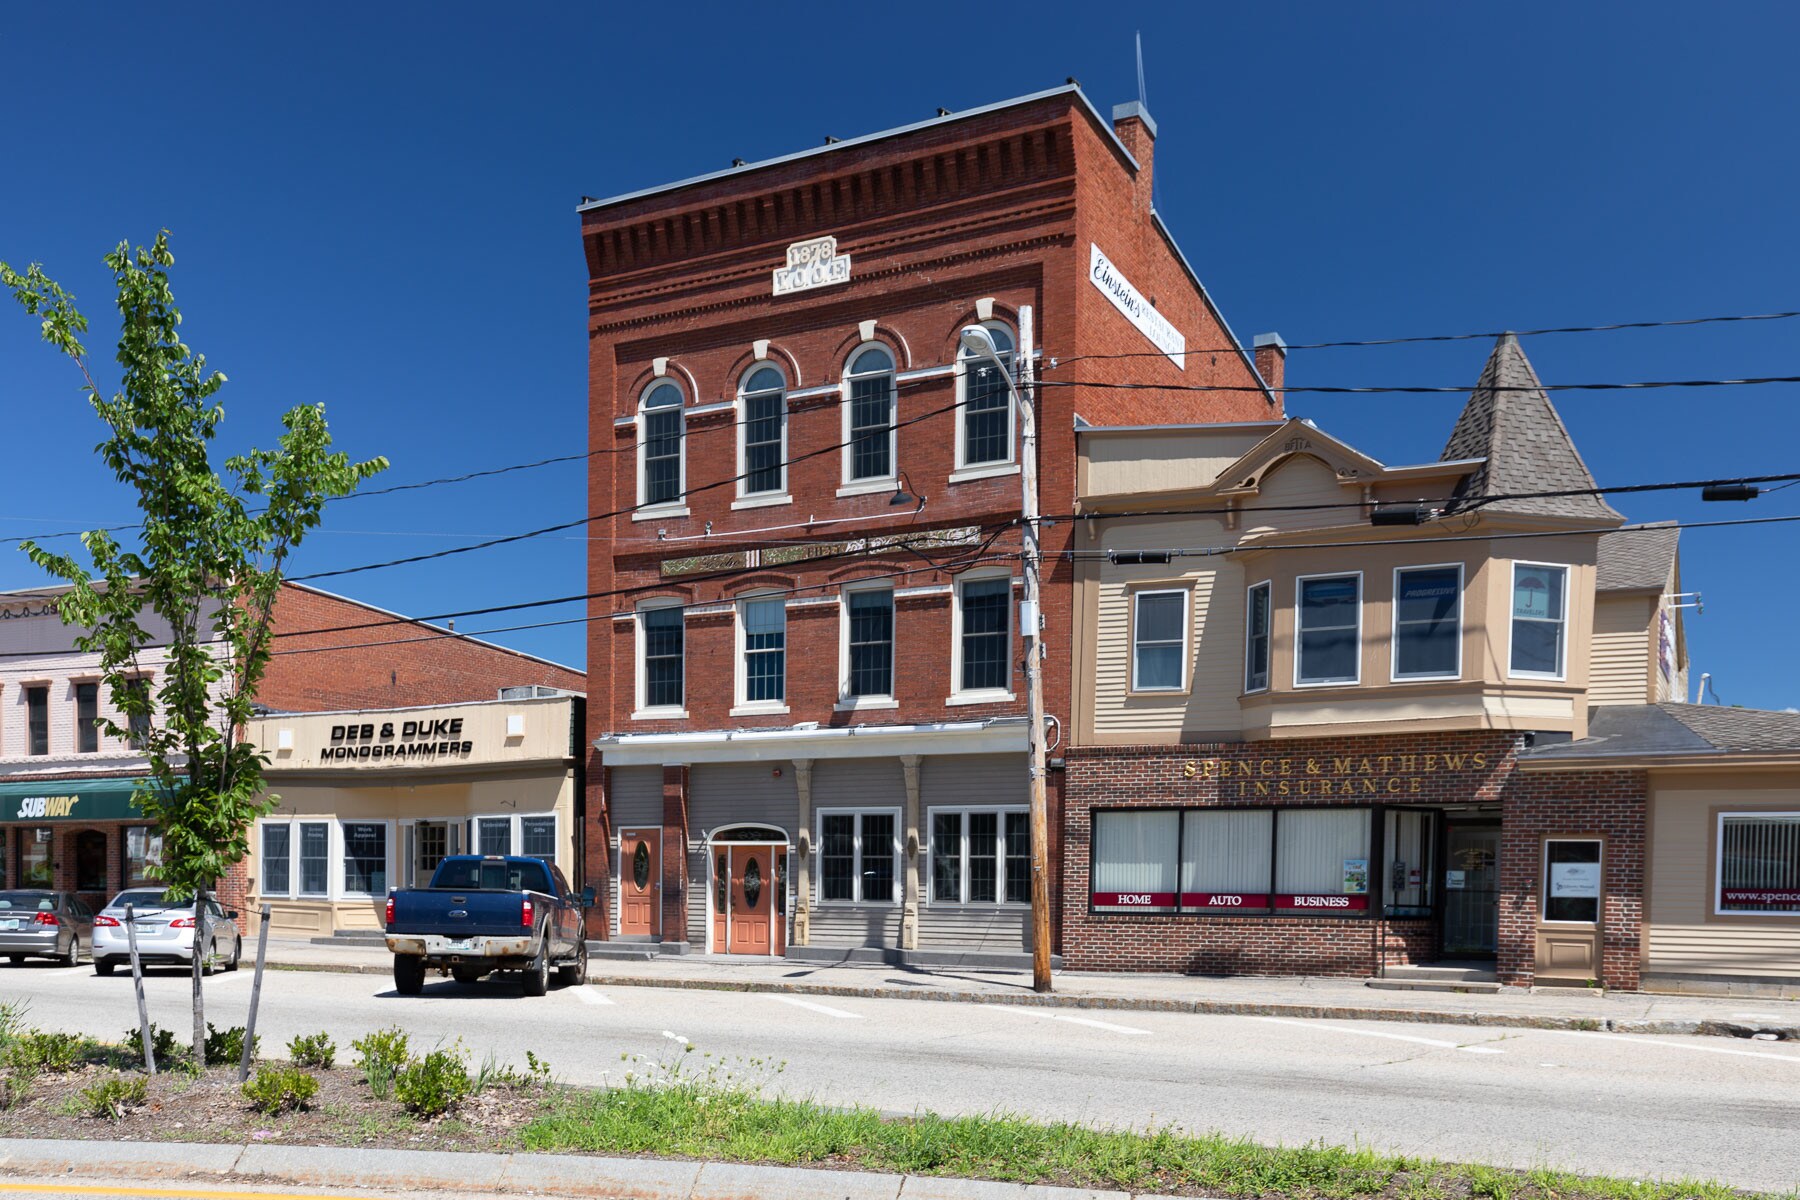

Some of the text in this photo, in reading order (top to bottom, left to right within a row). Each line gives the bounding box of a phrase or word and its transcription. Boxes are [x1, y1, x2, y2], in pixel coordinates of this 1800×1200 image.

[792, 242, 832, 265] 1878
[1093, 254, 1141, 318] Einstein's
[1404, 586, 1458, 598] PROGRESSIVE
[331, 718, 463, 741] DEB & DUKE
[320, 741, 473, 760] MONOGRAMMERS
[1184, 752, 1486, 778] SPENCE & MATHEWS
[1239, 777, 1422, 796] INSURANCE
[17, 795, 79, 818] SUBWAY
[1118, 895, 1151, 904] HOME
[1208, 895, 1242, 906] AUTO
[1293, 896, 1350, 907] BUSINESS
